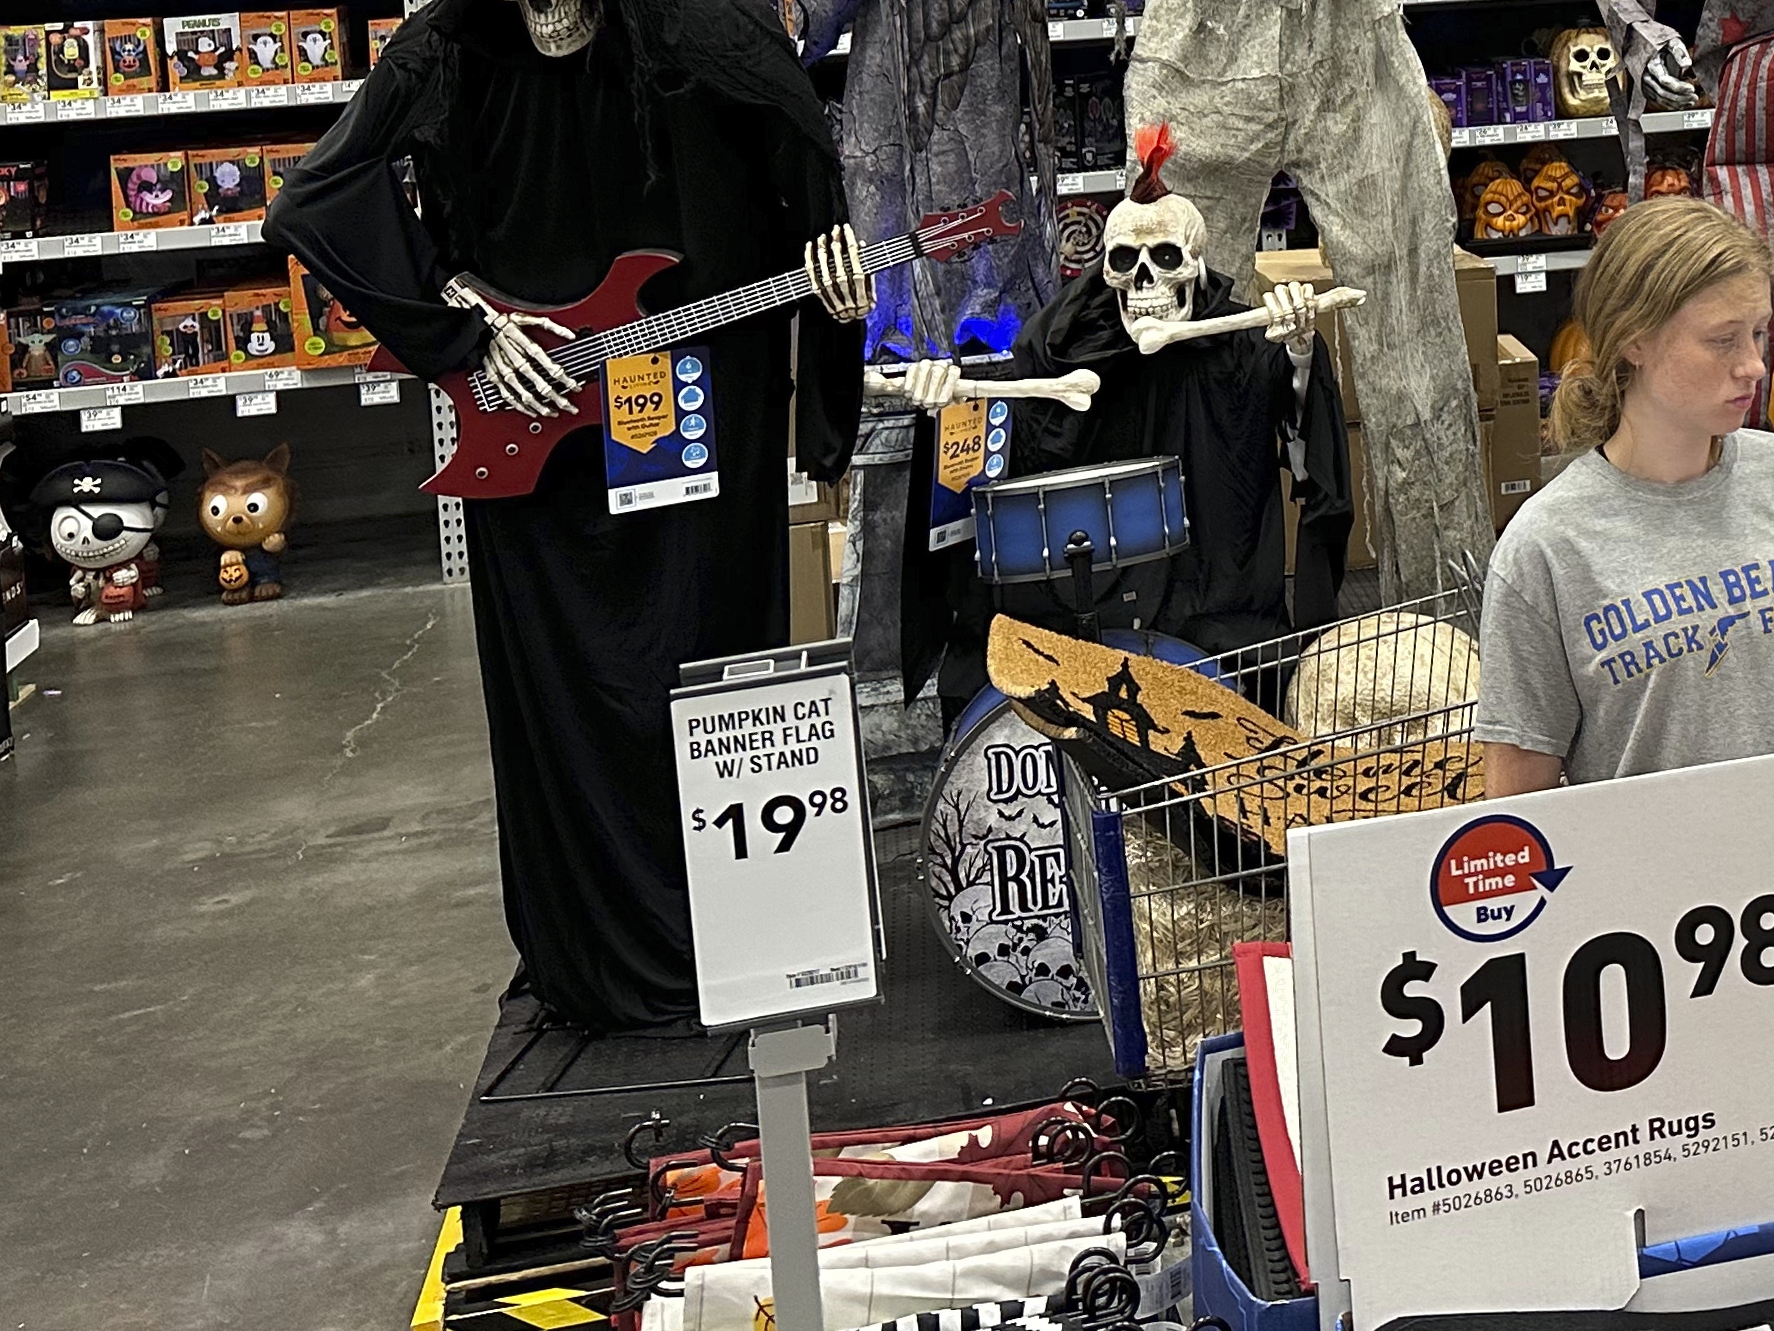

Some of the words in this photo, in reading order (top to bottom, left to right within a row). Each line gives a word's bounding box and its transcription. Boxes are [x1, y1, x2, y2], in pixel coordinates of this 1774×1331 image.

[181, 18, 221, 29] PEANUTS
[613, 371, 666, 386] HAUNTED
[614, 392, 663, 415] $199
[943, 435, 981, 460] $248
[1583, 575, 1718, 653] GOLDEN
[1600, 624, 1704, 686] TRACK
[688, 704, 786, 737] PUMPKIN
[793, 697, 832, 721] CAT
[689, 730, 775, 760] BANNER
[783, 720, 835, 745] FLAG
[715, 757, 744, 779] W/
[750, 746, 819, 775] STAND
[1449, 845, 1531, 877] Limited
[1463, 872, 1516, 896] Time
[1476, 902, 1515, 924] Buy
[1387, 1151, 1539, 1200] Halloween
[1546, 1119, 1641, 1165] Accent
[1649, 1109, 1717, 1142] Rugs
[1389, 1204, 1427, 1225] Item
[1432, 1182, 1519, 1217] #5026863,
[1524, 1164, 1599, 1195] 5026865,
[1604, 1145, 1677, 1177] 3761854,
[1682, 1130, 1755, 1160] 5292151,
